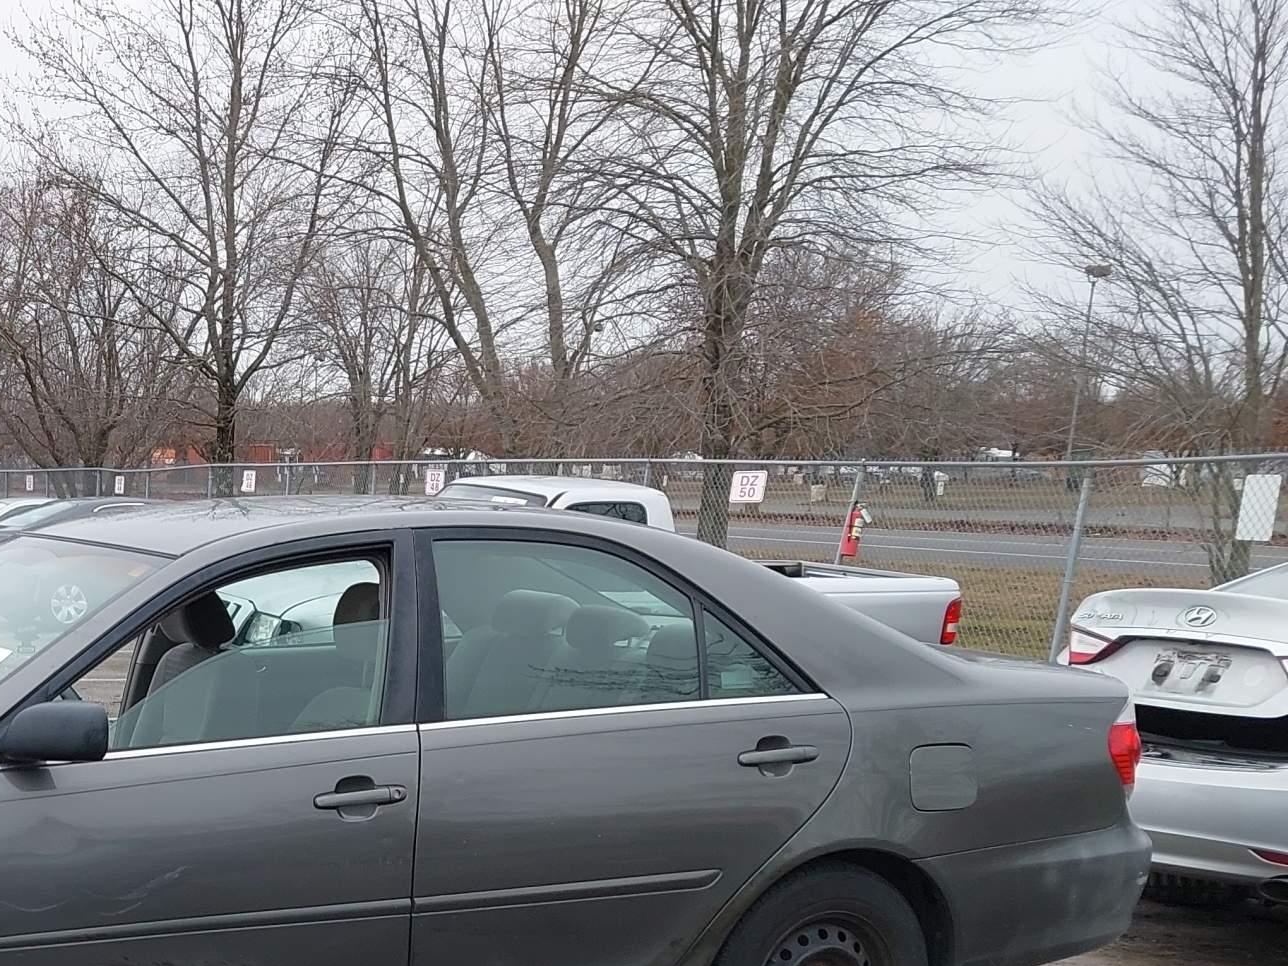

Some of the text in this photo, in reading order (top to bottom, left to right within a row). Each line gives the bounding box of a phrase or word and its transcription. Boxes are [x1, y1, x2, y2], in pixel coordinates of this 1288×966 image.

[430, 472, 441, 482] DZ
[740, 475, 760, 487] DZ
[739, 487, 756, 498] 50
